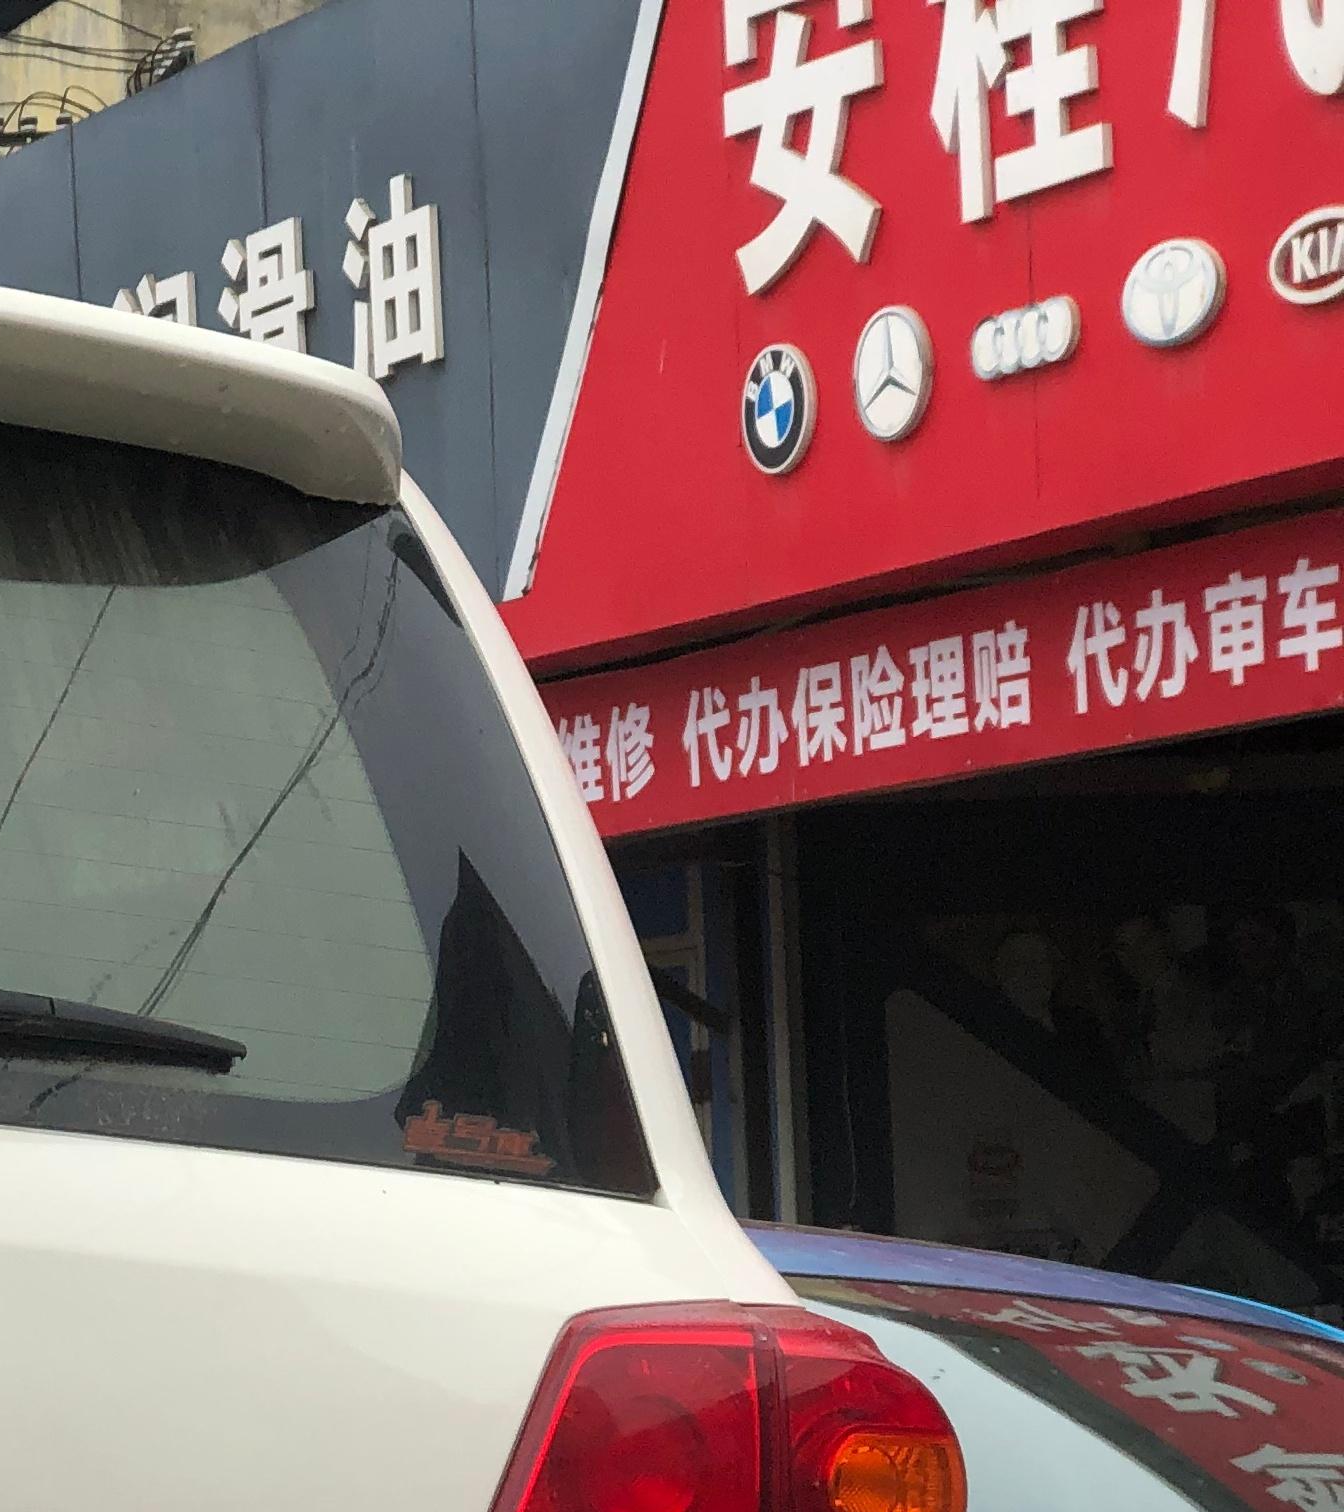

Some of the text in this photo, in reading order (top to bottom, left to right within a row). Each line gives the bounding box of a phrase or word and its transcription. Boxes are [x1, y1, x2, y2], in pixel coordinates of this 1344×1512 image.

[682, 619, 1032, 788] 代办保险理赔
[1066, 557, 1344, 715] 代办审车
